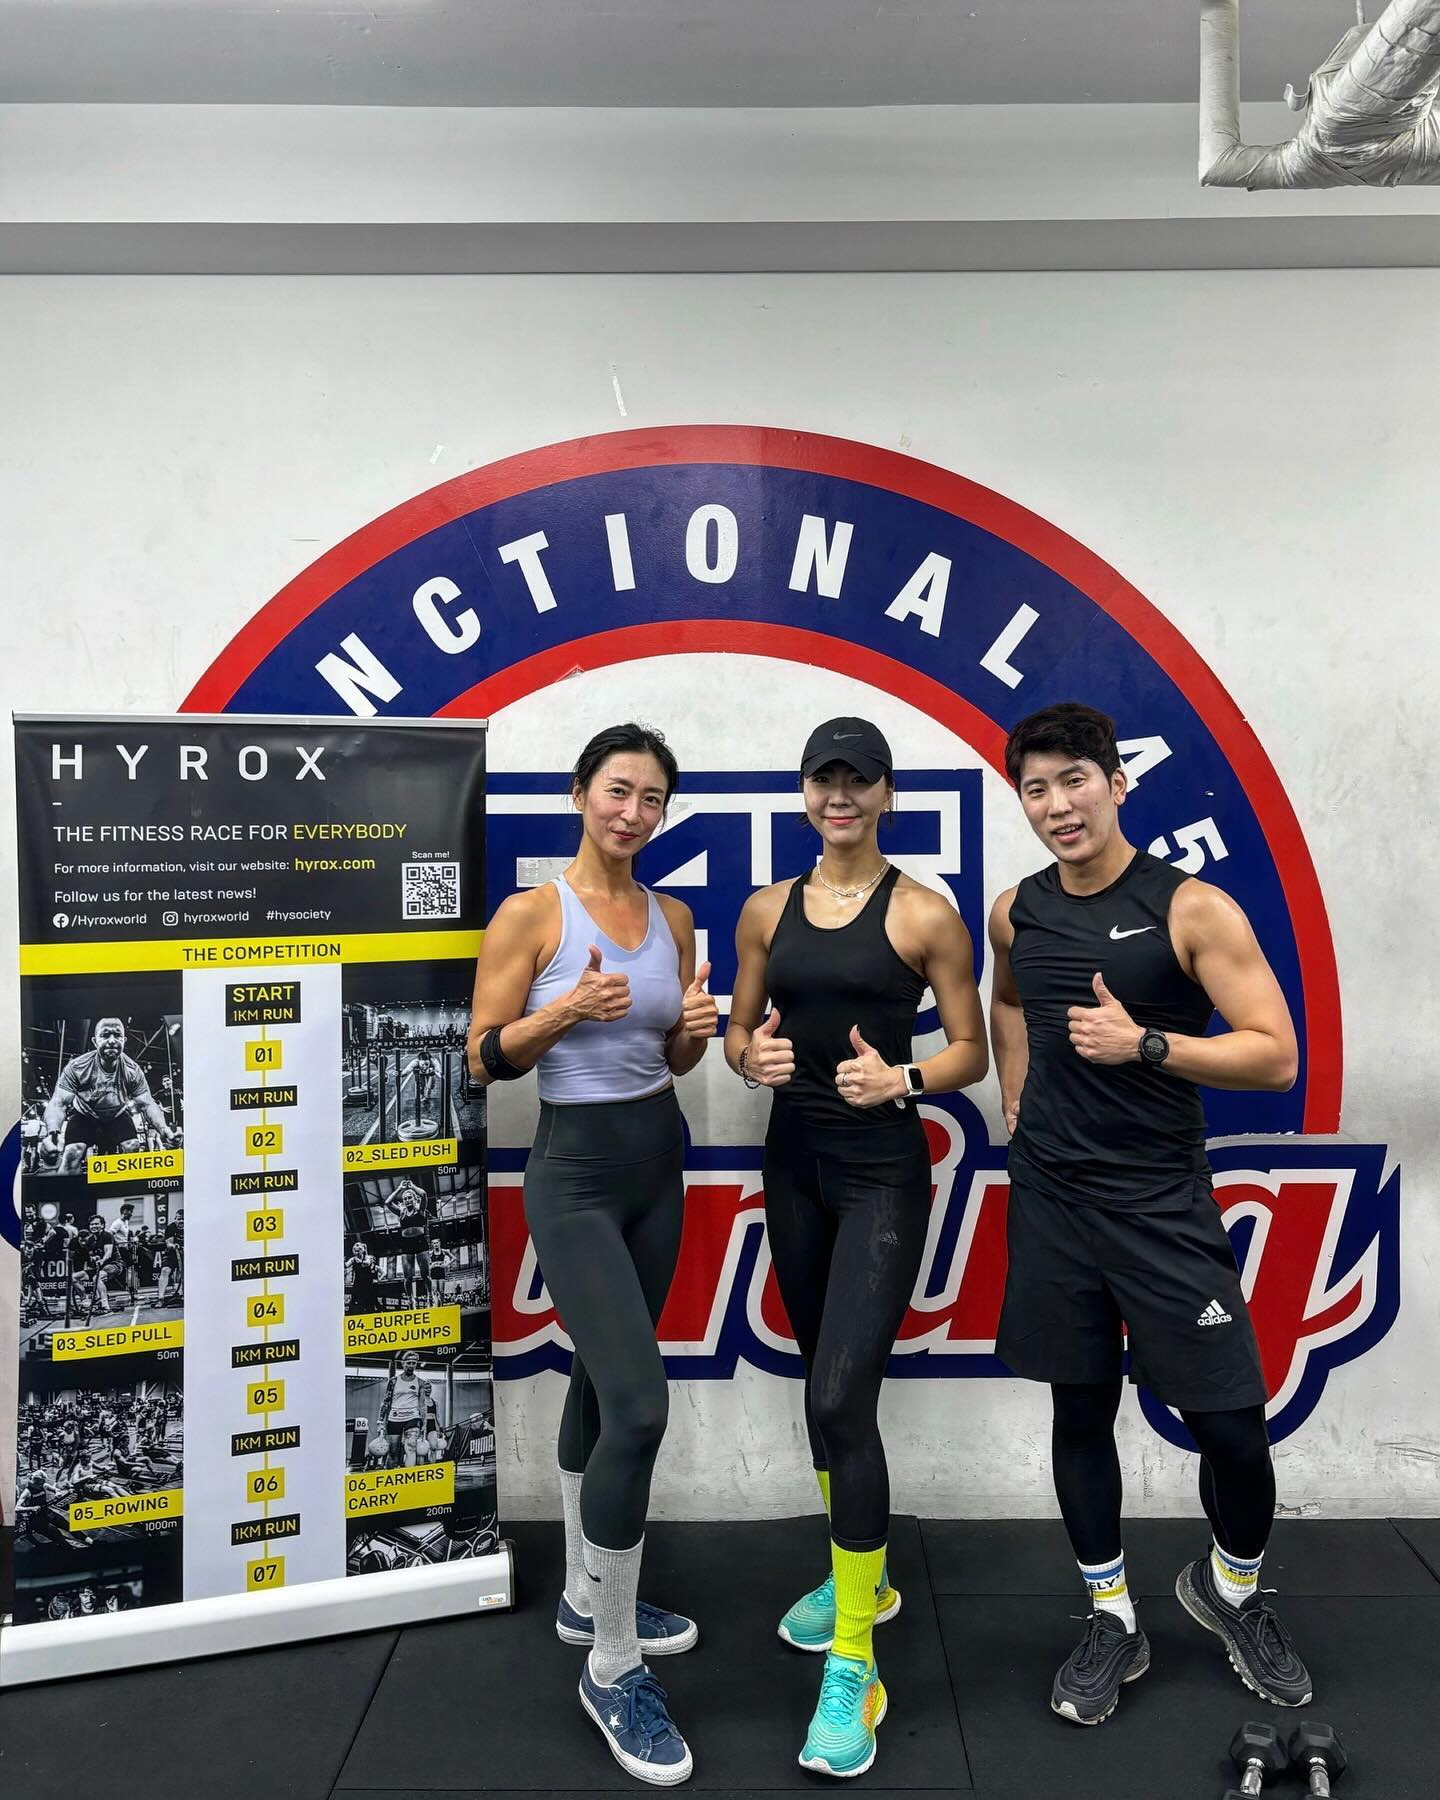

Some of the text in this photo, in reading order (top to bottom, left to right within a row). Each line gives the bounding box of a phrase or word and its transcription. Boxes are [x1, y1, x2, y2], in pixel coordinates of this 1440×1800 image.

[315, 503, 1040, 717] NCTIONAL
[53, 745, 325, 780] HYROX
[53, 824, 406, 841] THE FITNESS RACE FOR EVERYBODY
[54, 858, 375, 874] For more information, visit our website: hyrox.com
[54, 888, 256, 903] Follow us for the latest news!
[72, 914, 146, 927] /Hyroxworld
[184, 911, 249, 924] hyroxworld
[266, 911, 331, 921] #hysociety
[183, 944, 340, 961] THE COMPETITION
[233, 986, 294, 1002] START
[234, 1008, 292, 1021] 1KM RUN
[256, 1048, 272, 1062] 01
[234, 1091, 293, 1104] 1KM RUN
[253, 1132, 275, 1147] 02
[347, 1144, 450, 1163] 02_SLED PUSH
[93, 1156, 174, 1173] 01_SKIERG
[437, 1165, 457, 1174] 50m
[147, 1179, 179, 1189] 1000m
[235, 1175, 293, 1190] 1KM RUN
[254, 1217, 276, 1232] 03
[236, 1260, 294, 1276] 1KM RUN
[254, 1302, 277, 1318] 04
[347, 1312, 430, 1331] 04_BURPEE
[1197, 1314, 1232, 1326] adidas
[57, 1327, 172, 1351] 03_SLED PULL
[348, 1326, 450, 1346] BROAD JUMPS
[158, 1351, 179, 1360] 50m
[236, 1345, 295, 1362] 1KM RUN
[437, 1346, 457, 1355] 80m
[254, 1388, 277, 1405] 05
[236, 1432, 295, 1450] 1KM RUN
[254, 1476, 277, 1493] 06
[348, 1468, 444, 1492] 06_FARMERS
[74, 1497, 169, 1520] 05_ROWING
[349, 1493, 398, 1510] CARRY
[427, 1506, 452, 1517] 200m
[145, 1520, 177, 1532] 1000m
[235, 1519, 296, 1539] 1KM RUN
[254, 1565, 276, 1582] 07
